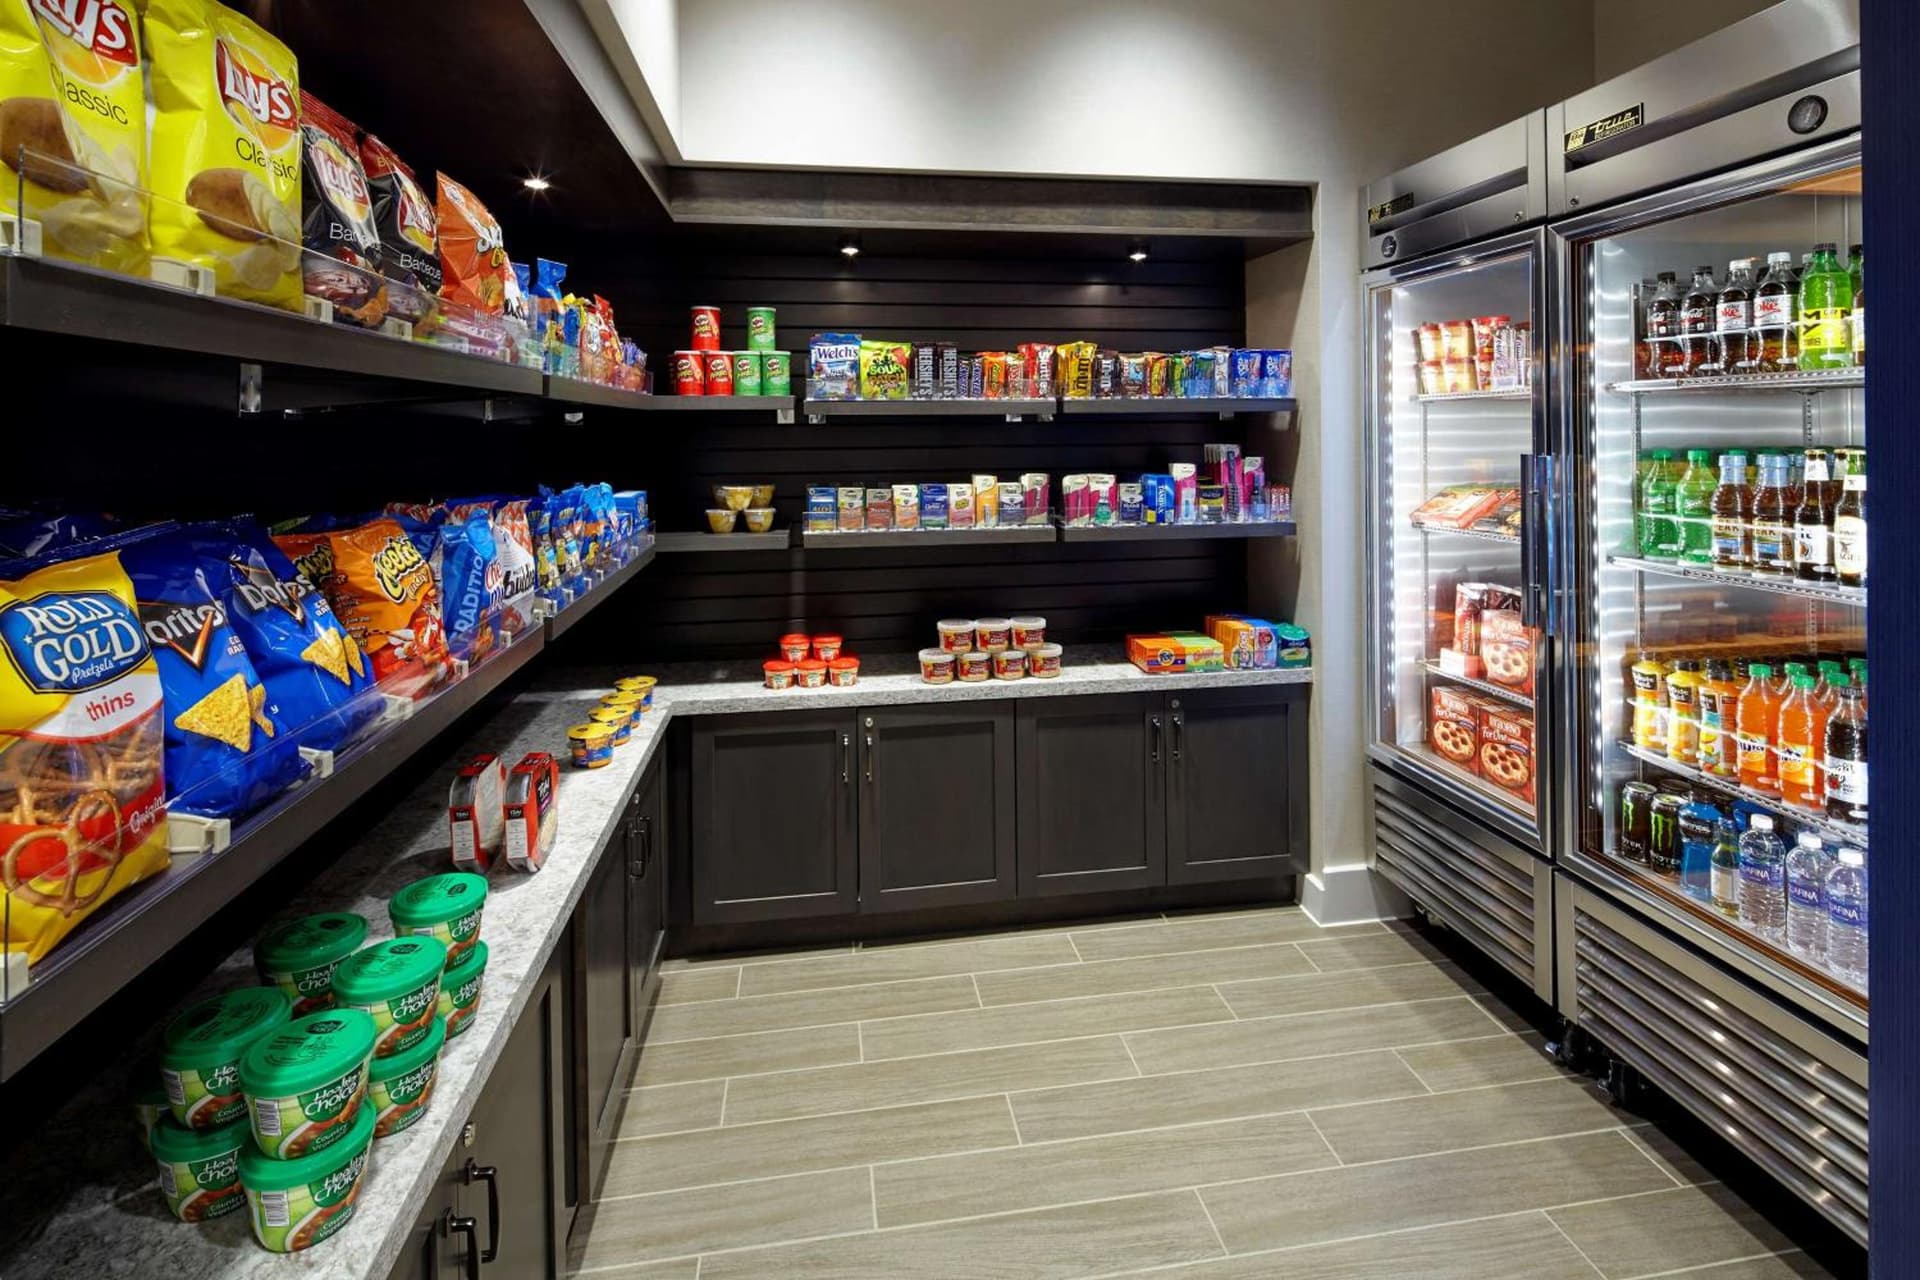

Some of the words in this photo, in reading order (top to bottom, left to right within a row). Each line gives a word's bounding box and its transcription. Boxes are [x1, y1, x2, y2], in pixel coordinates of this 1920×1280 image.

[50, 62, 128, 125] Classic
[222, 50, 292, 123] Lay's
[817, 347, 857, 360] Welch's
[918, 347, 933, 397] HERSHEY'S
[943, 347, 957, 398] HERSHEY'S
[14, 598, 113, 638] ROLD
[146, 598, 225, 648] oritos
[449, 555, 482, 646] TRADITIO
[33, 615, 144, 683] GOLD
[71, 660, 115, 684] Pretzels
[86, 690, 137, 722] thins
[217, 1101, 247, 1117] Countr
[197, 1163, 238, 1184] Choi
